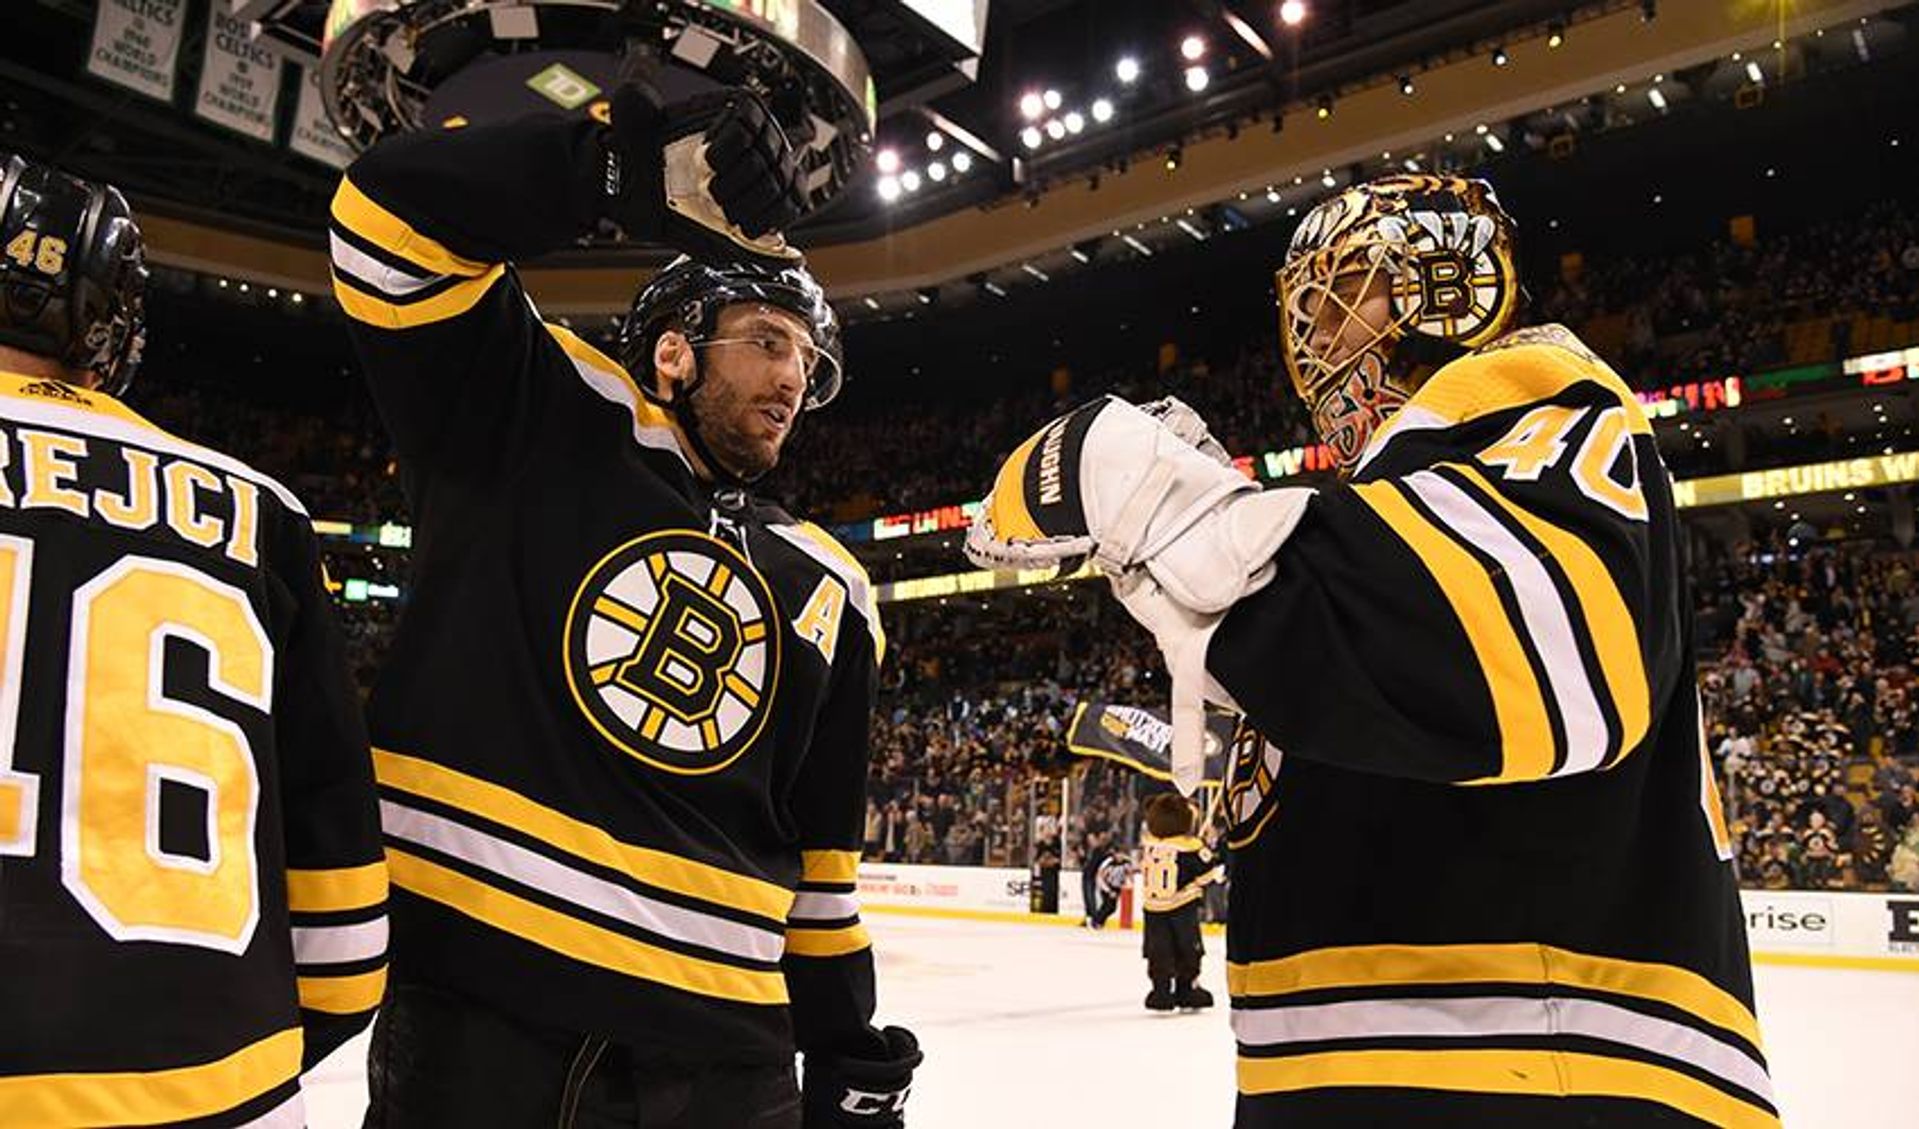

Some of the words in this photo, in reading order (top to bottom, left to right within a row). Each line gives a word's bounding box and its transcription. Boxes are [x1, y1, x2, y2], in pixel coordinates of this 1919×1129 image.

[545, 73, 586, 99] TD
[7, 229, 68, 275] 46
[1475, 405, 1649, 522] 40
[1741, 459, 1874, 500] BRUINS
[616, 571, 743, 722] B
[792, 574, 848, 666] A
